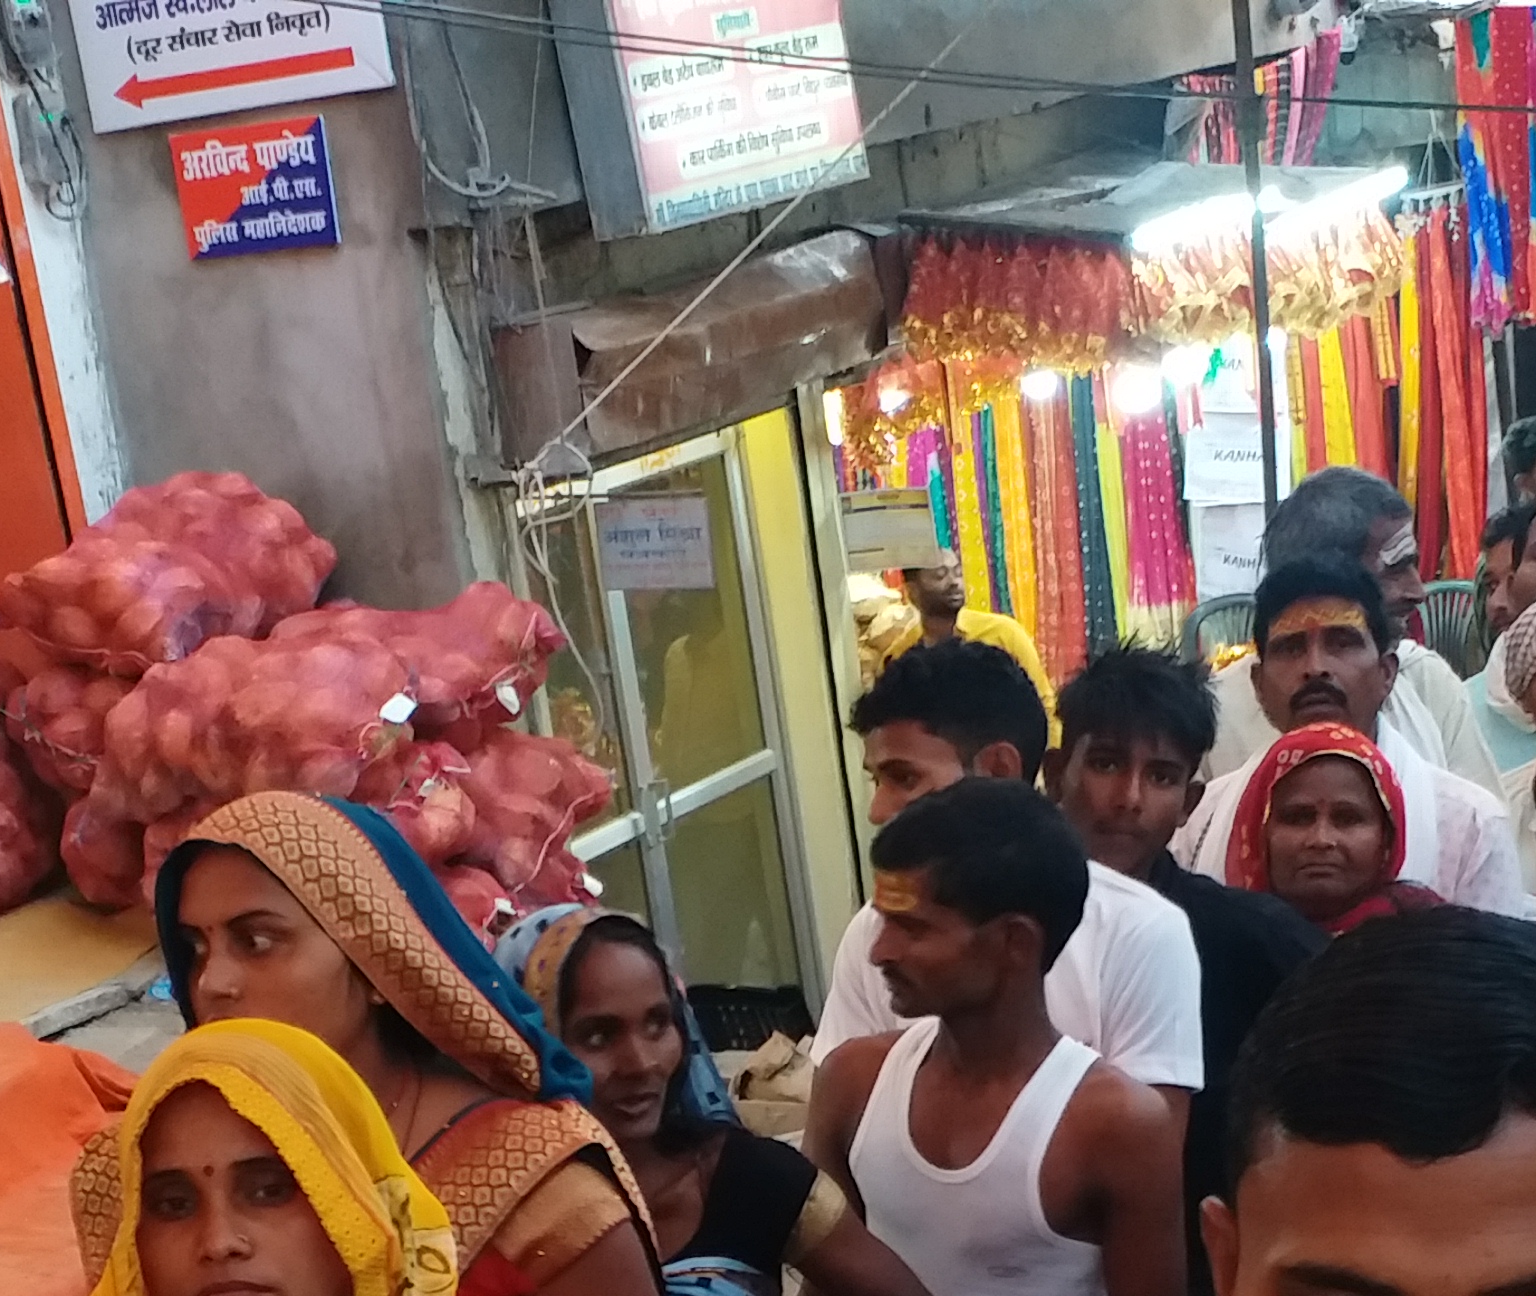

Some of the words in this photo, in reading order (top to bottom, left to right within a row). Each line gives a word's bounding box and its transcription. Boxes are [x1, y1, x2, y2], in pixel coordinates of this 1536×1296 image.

[126, 35, 163, 64] (दूर
[165, 26, 219, 52] संचार
[221, 20, 263, 43] सेवा
[180, 139, 250, 181] अरविन्द
[253, 129, 316, 171] पाण्डेय
[240, 175, 323, 206] आई.पी.एस.
[193, 219, 240, 253] पुलिस
[241, 208, 327, 240] महानिदेशक
